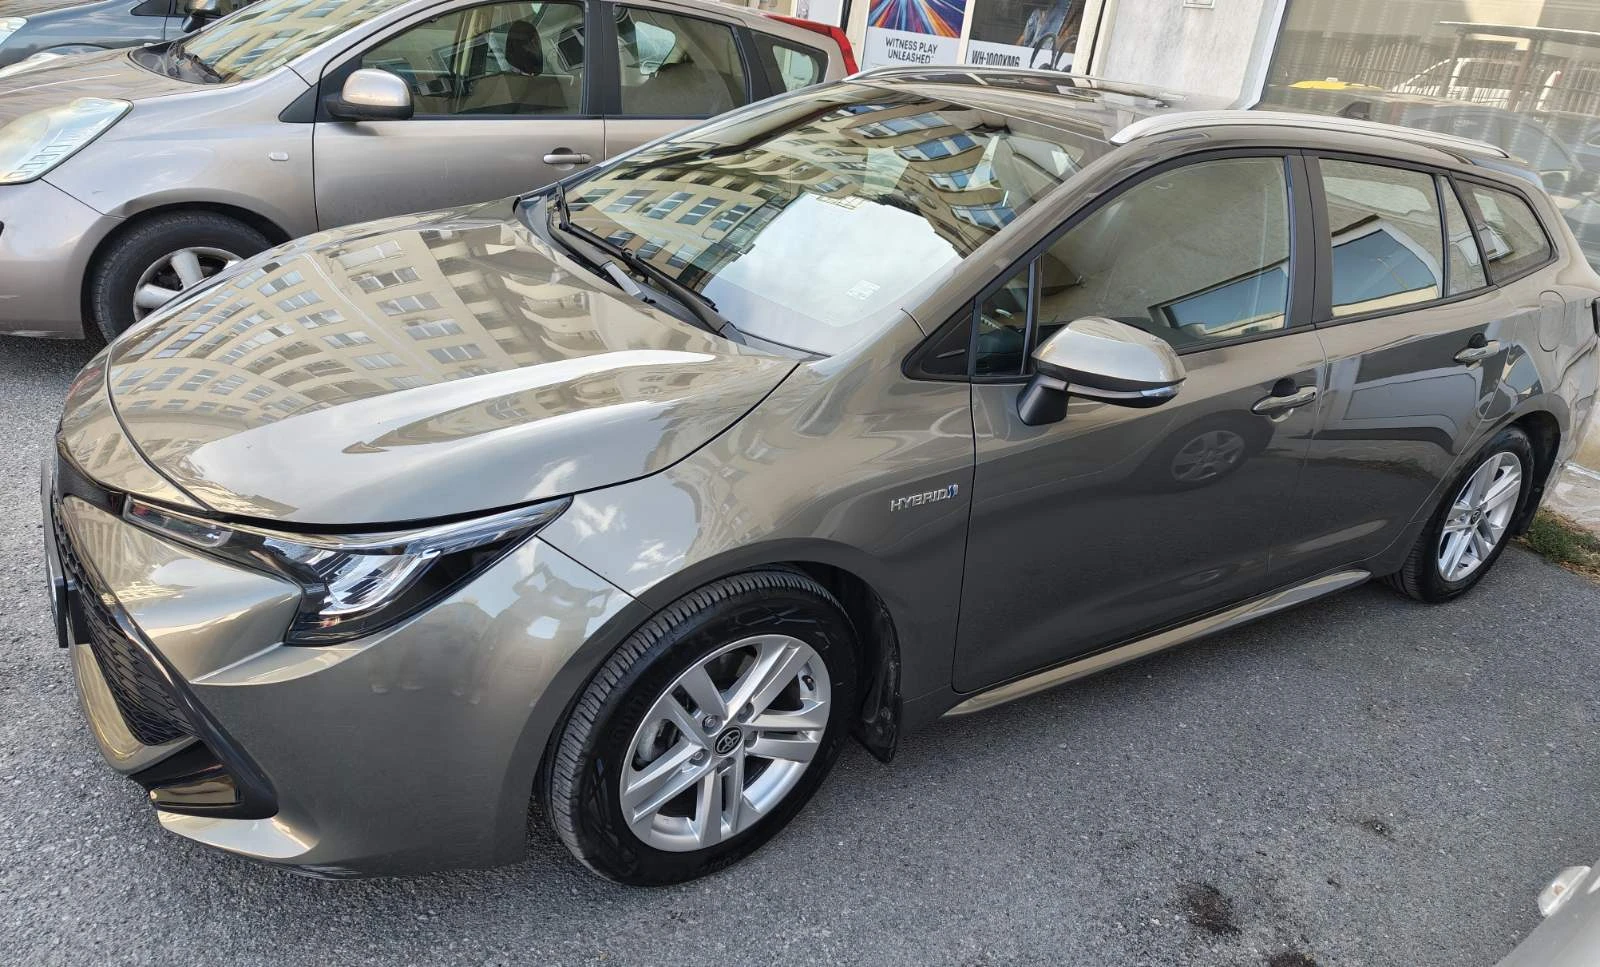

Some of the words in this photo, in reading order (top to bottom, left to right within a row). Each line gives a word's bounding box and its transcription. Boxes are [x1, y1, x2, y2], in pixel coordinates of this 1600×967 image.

[885, 36, 918, 51] WITNESS
[919, 42, 938, 54] PLAY
[888, 48, 931, 64] UNLEASHED
[890, 488, 951, 512] HYBRID
